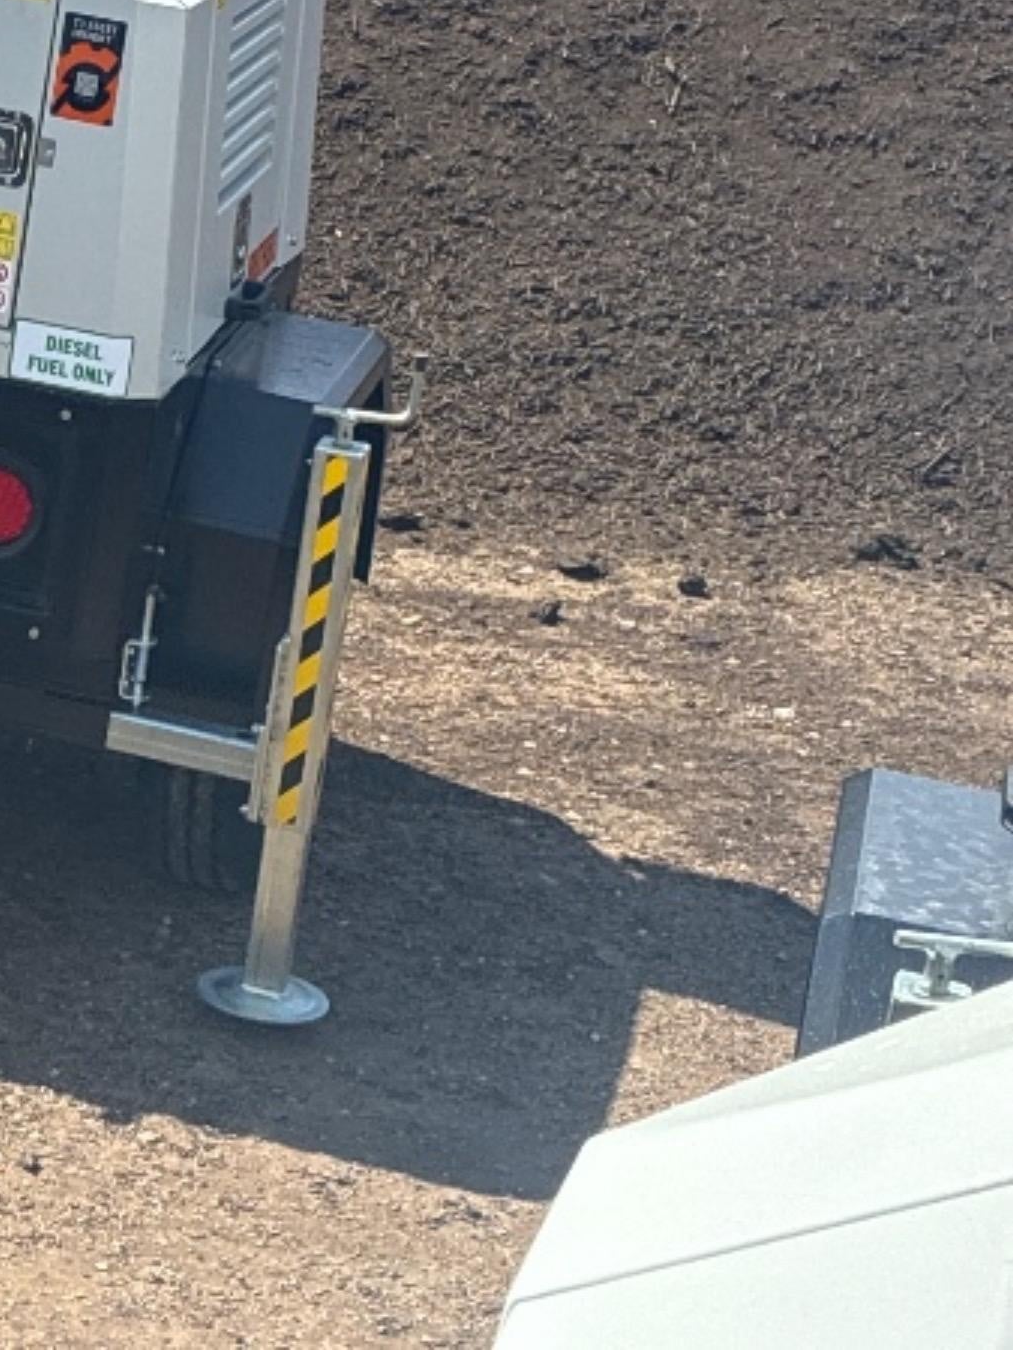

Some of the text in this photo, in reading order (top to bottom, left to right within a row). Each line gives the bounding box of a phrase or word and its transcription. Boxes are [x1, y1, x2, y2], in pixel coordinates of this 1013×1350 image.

[45, 334, 103, 361] DIESEL
[27, 353, 116, 388] FUEL ONLY
